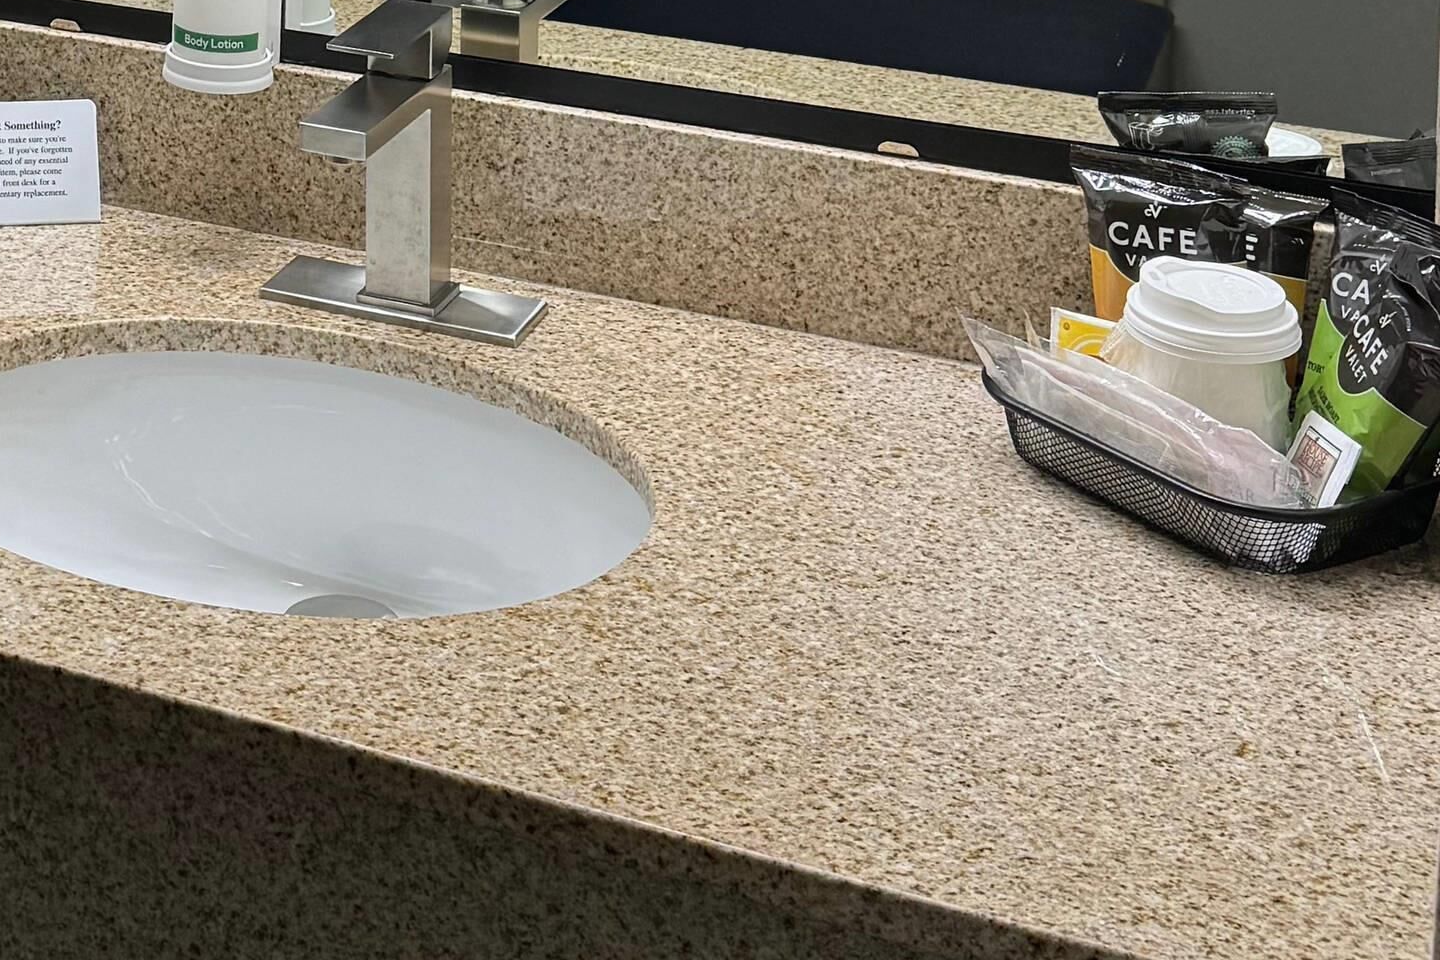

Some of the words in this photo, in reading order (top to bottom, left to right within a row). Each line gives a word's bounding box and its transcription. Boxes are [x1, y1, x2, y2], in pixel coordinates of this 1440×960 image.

[184, 33, 209, 50] Body
[211, 38, 244, 49] Lotion
[4, 119, 61, 131] Something?
[8, 136, 27, 144] make
[45, 135, 66, 145] you're
[16, 147, 38, 156] you've
[41, 146, 73, 155] forgotten
[14, 157, 23, 165] of
[24, 158, 36, 167] any
[38, 156, 69, 164] essential
[0, 168, 18, 177] item,
[19, 167, 42, 177] please
[2, 179, 20, 187] front
[21, 178, 37, 186] desk
[40, 178, 50, 186] for
[24, 189, 68, 199] replacement.
[1331, 272, 1370, 306] CA
[1344, 344, 1368, 384] VALET
